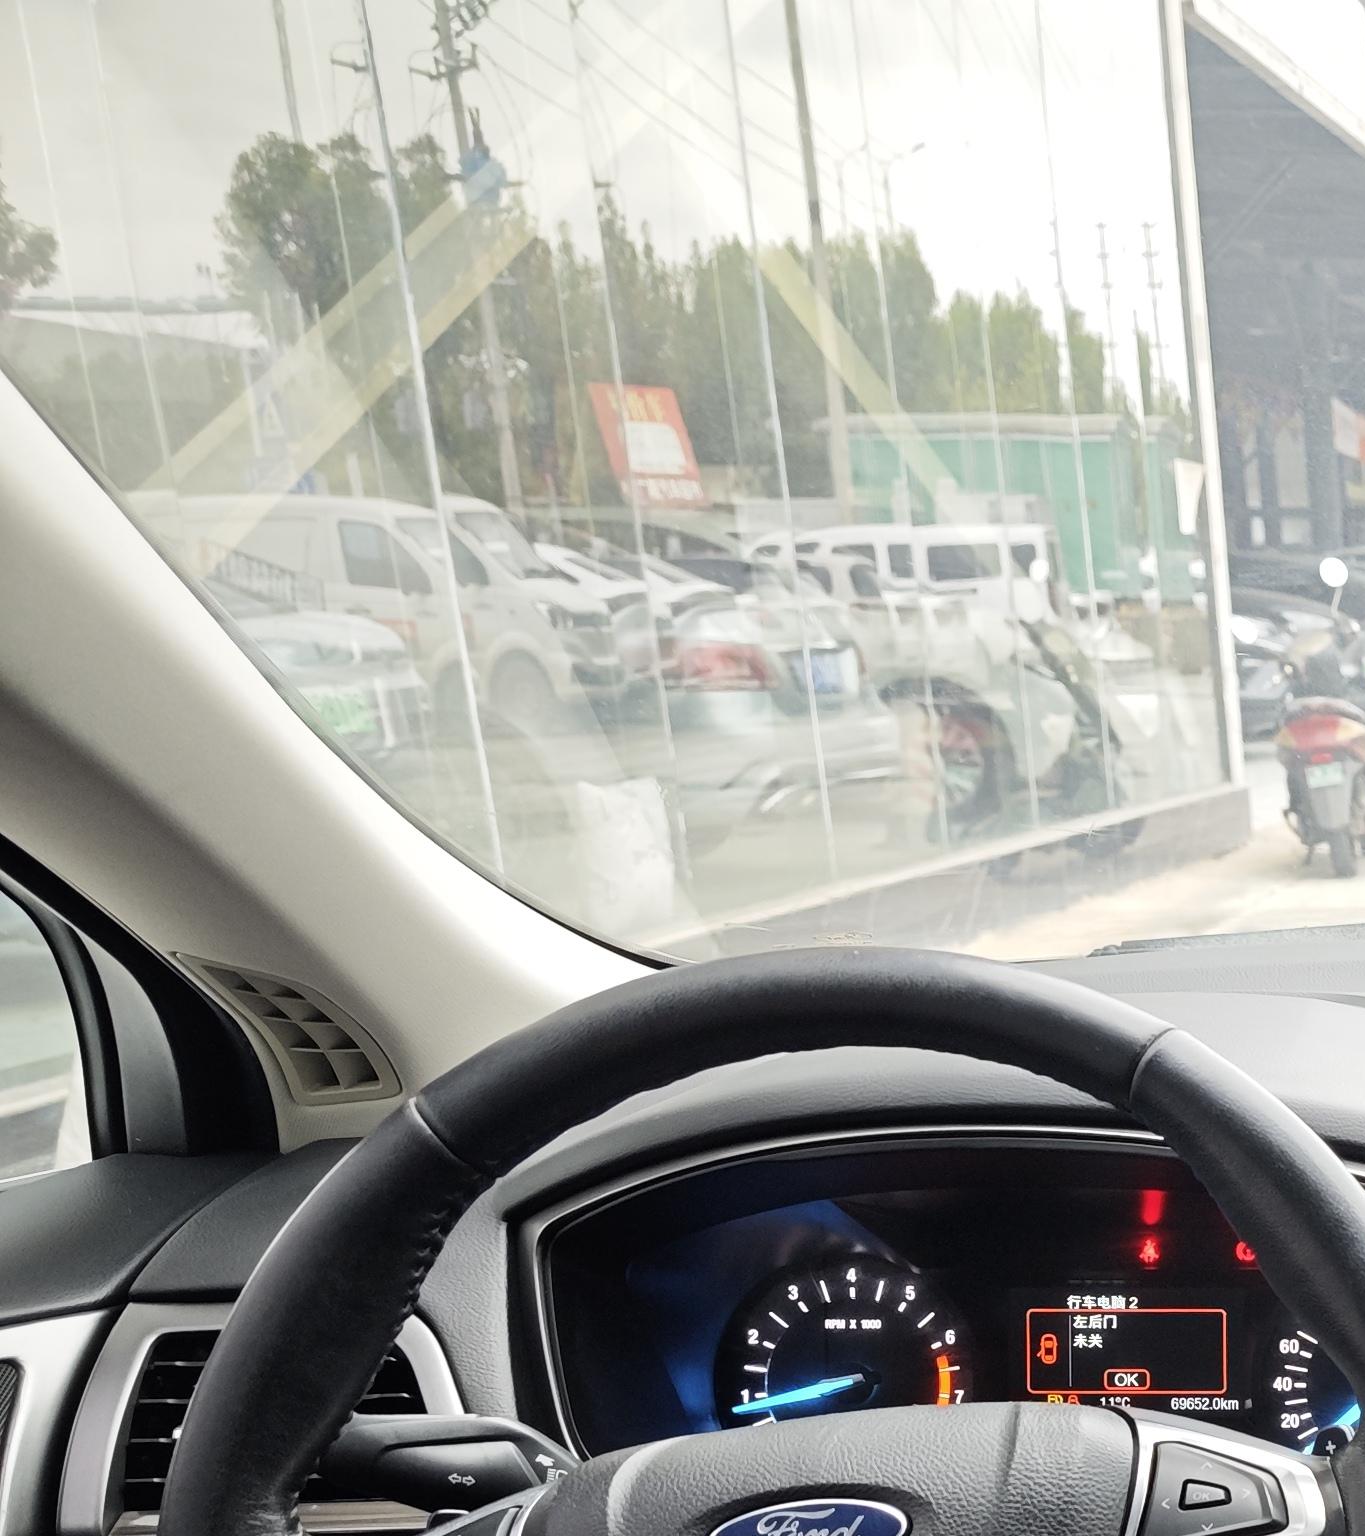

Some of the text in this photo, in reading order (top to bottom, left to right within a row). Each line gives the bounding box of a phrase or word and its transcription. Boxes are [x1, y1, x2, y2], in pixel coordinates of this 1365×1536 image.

[845, 1267, 857, 1283] 4
[787, 1285, 799, 1300] 3
[904, 1285, 916, 1300] 5
[1066, 1295, 1139, 1310] 行车电脑 2
[824, 1319, 846, 1330] RPM
[860, 1319, 882, 1330] 1000
[1072, 1314, 1118, 1330] 左后门
[747, 1328, 759, 1345] 2
[944, 1329, 956, 1345] 6
[1073, 1333, 1103, 1349] 未关
[1279, 1338, 1300, 1355] 60
[1113, 1373, 1139, 1388] OK
[1273, 1376, 1293, 1392] 40
[740, 1388, 750, 1404] 1
[953, 1389, 965, 1405] 7
[1170, 1397, 1240, 1411] 69652.0km
[1280, 1413, 1300, 1429] 20
[1192, 1491, 1210, 1501] OK
